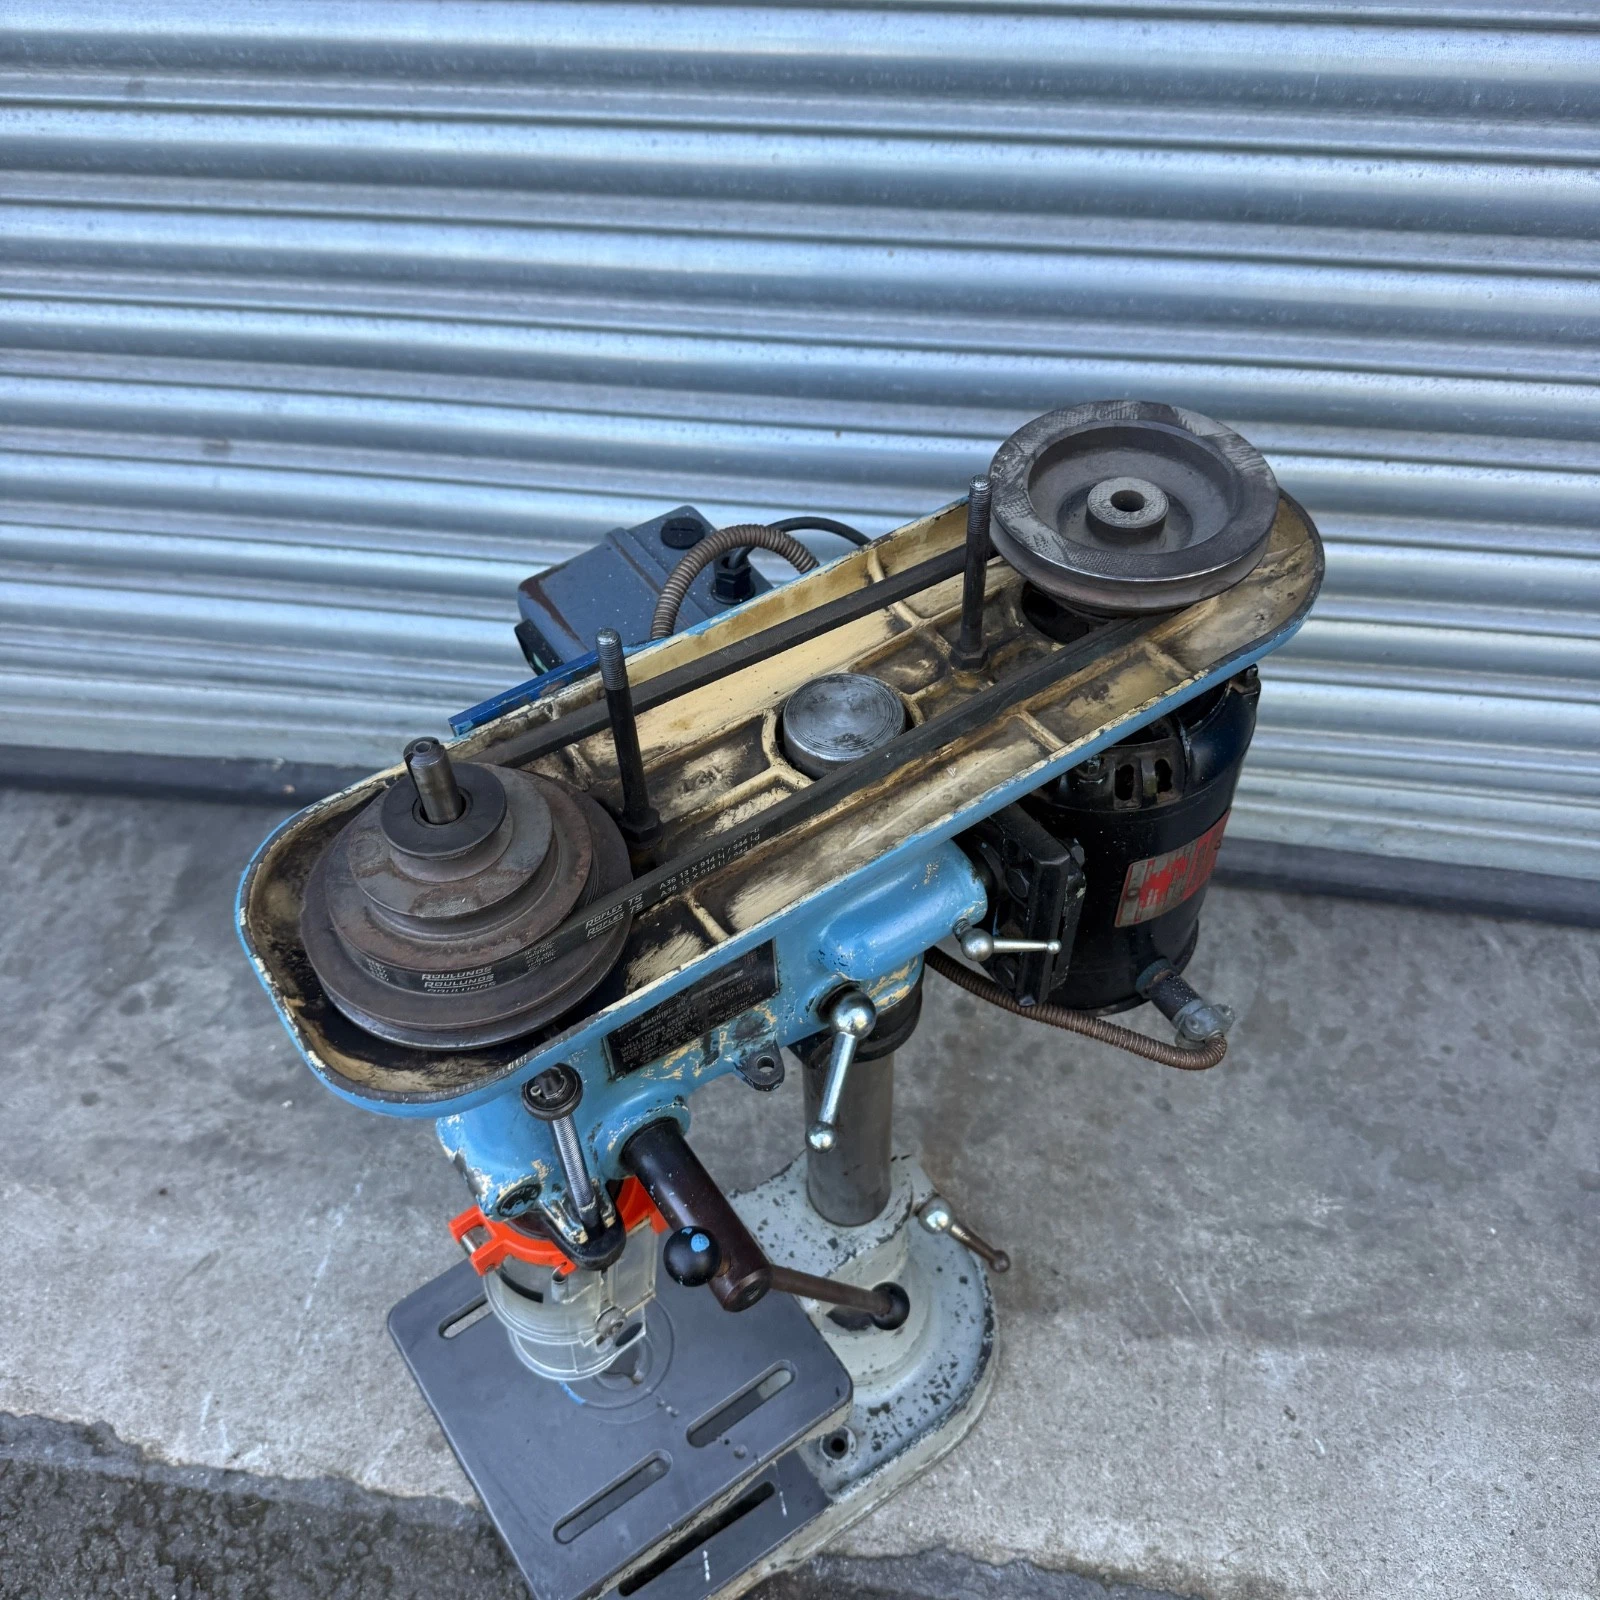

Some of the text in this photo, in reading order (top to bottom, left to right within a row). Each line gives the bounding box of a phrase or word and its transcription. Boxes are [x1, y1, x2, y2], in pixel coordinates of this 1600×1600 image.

[660, 877, 677, 890] A36
[680, 869, 689, 878] 13
[700, 856, 715, 868] 914
[733, 839, 748, 851] 944
[585, 904, 623, 929] ROFLEX
[587, 912, 624, 937] ROFLEX
[422, 967, 493, 981] ROULUNDS
[424, 974, 495, 988] ROULUNDS
